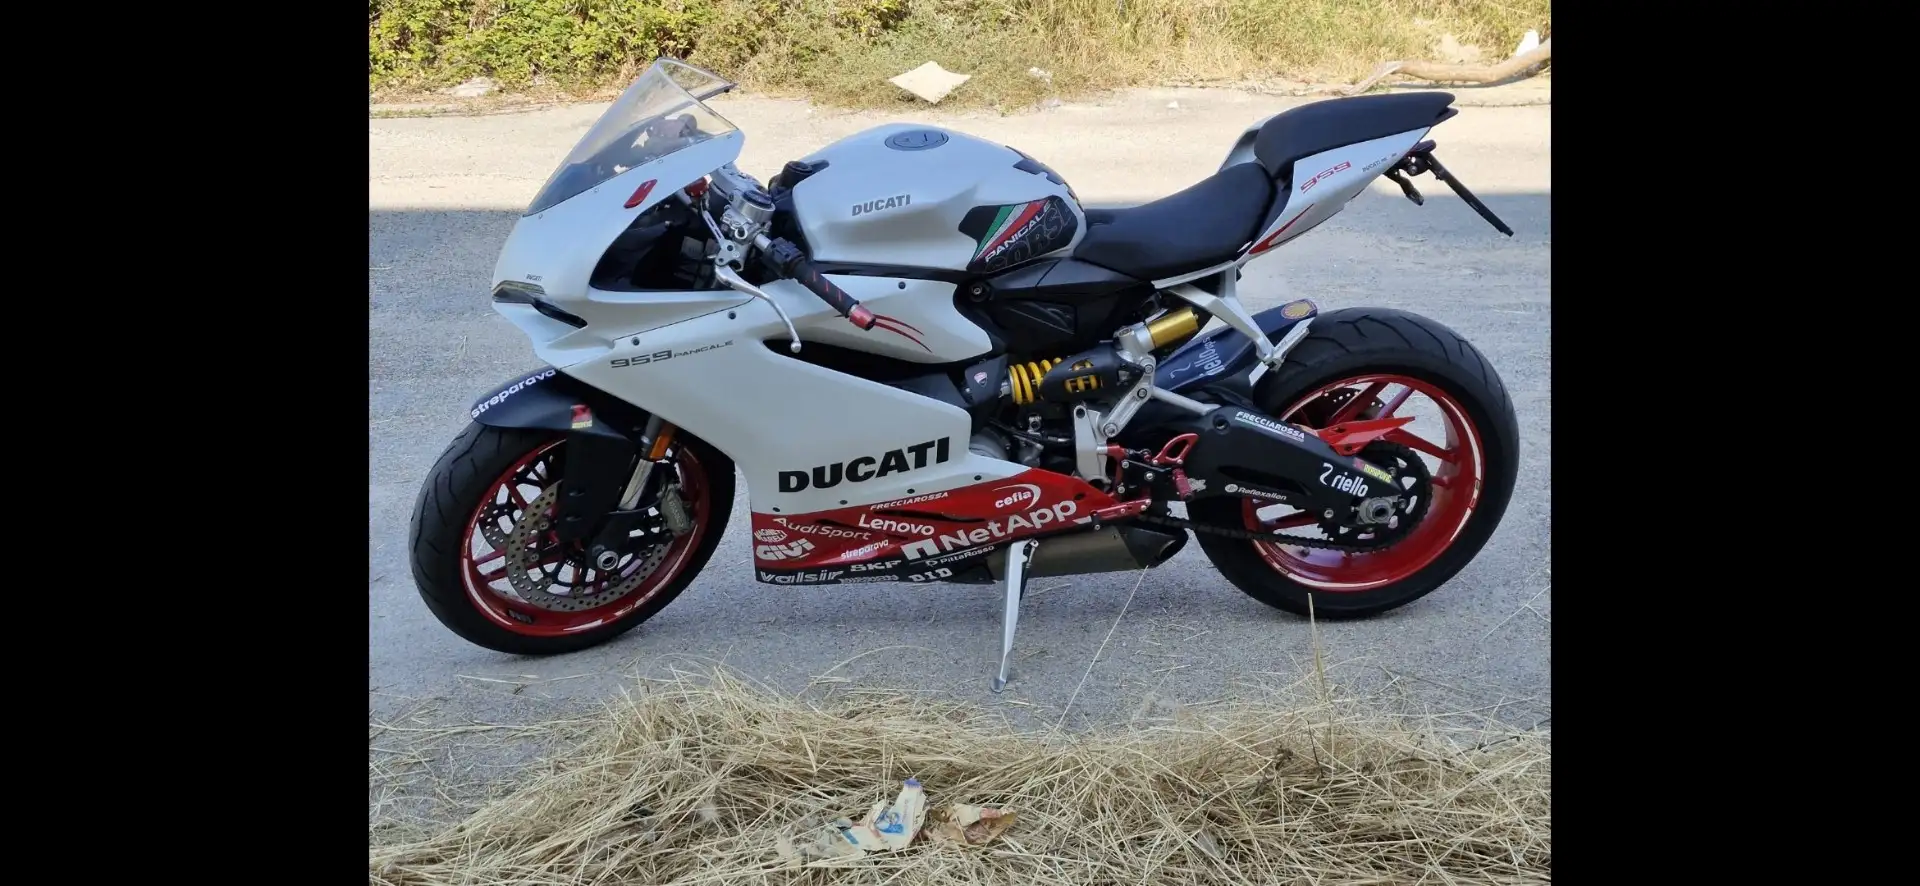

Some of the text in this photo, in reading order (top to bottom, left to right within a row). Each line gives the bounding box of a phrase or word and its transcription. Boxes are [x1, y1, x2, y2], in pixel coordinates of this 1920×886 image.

[1300, 161, 1352, 194] 959
[851, 194, 911, 216] DUCATI
[610, 349, 672, 368] 959
[470, 368, 556, 419] streparava
[1236, 411, 1305, 439] FRECCIAROSSA
[778, 436, 950, 493] DUCATI
[1331, 471, 1369, 497] riello
[870, 491, 950, 511] FRECCIAROSSA
[772, 517, 872, 540] Audi Sport
[858, 513, 935, 536] Lenovo
[940, 499, 1077, 551] NetApp
[840, 538, 889, 560] streparava
[850, 559, 902, 572] SKF
